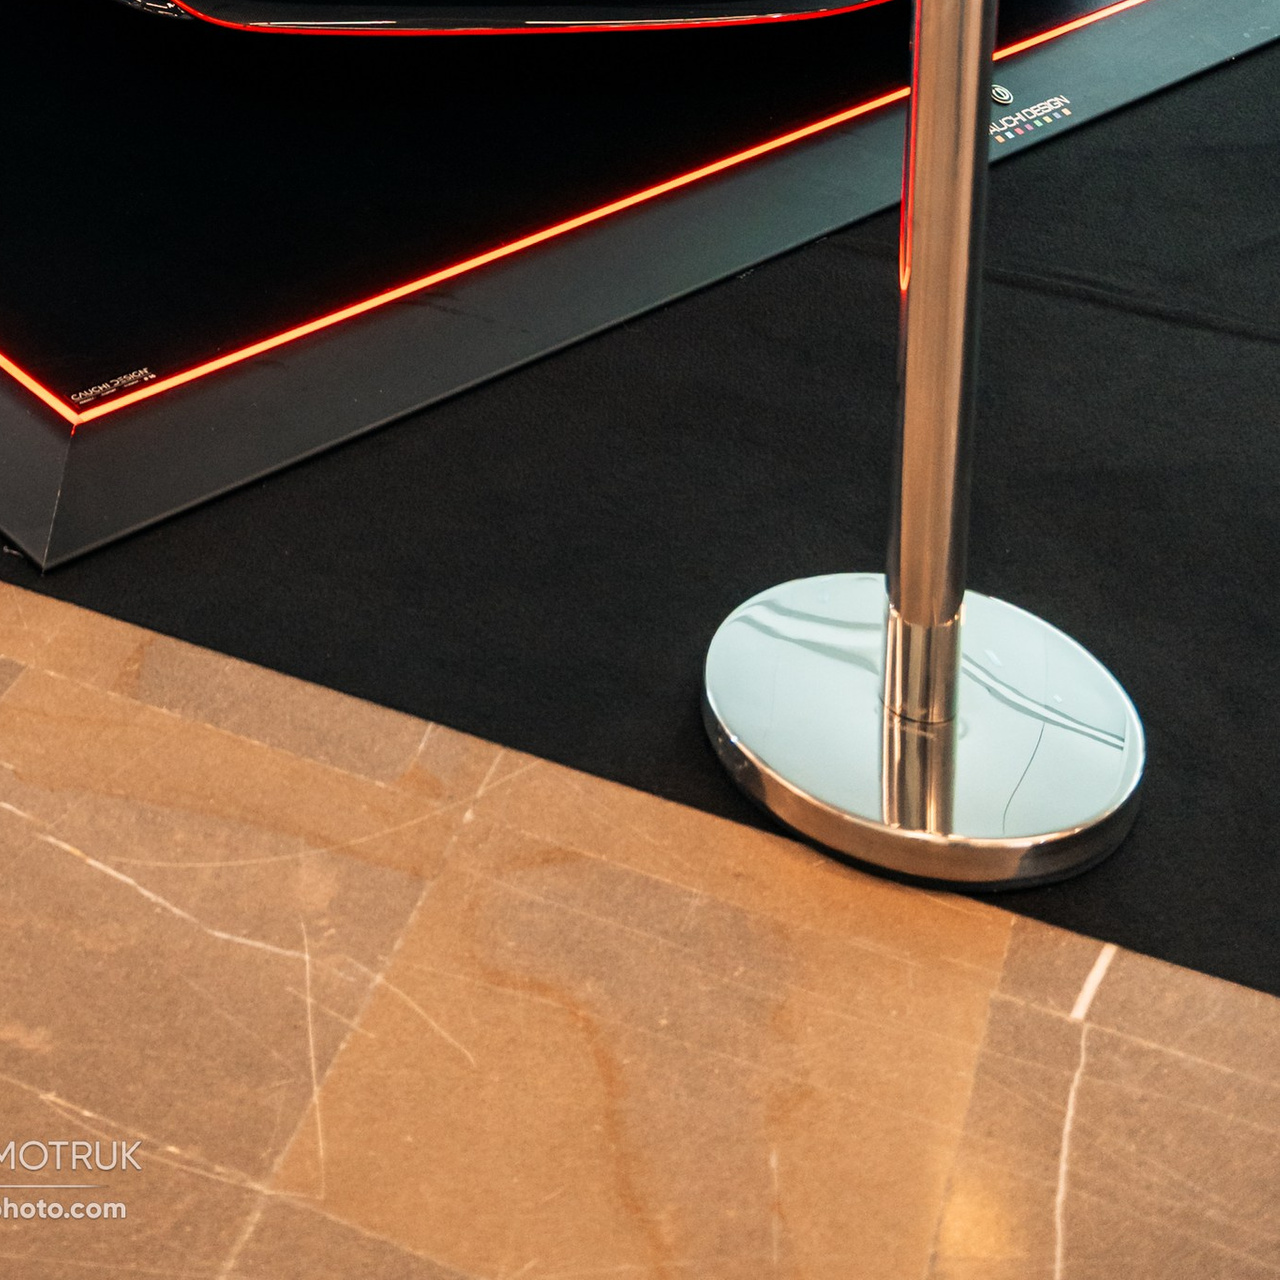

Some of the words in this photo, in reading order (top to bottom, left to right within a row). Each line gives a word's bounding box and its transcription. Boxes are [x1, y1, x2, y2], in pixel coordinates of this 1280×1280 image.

[988, 110, 1027, 135] AUCHI
[1021, 95, 1071, 120] DESIGN
[70, 382, 112, 401] CAUCHI
